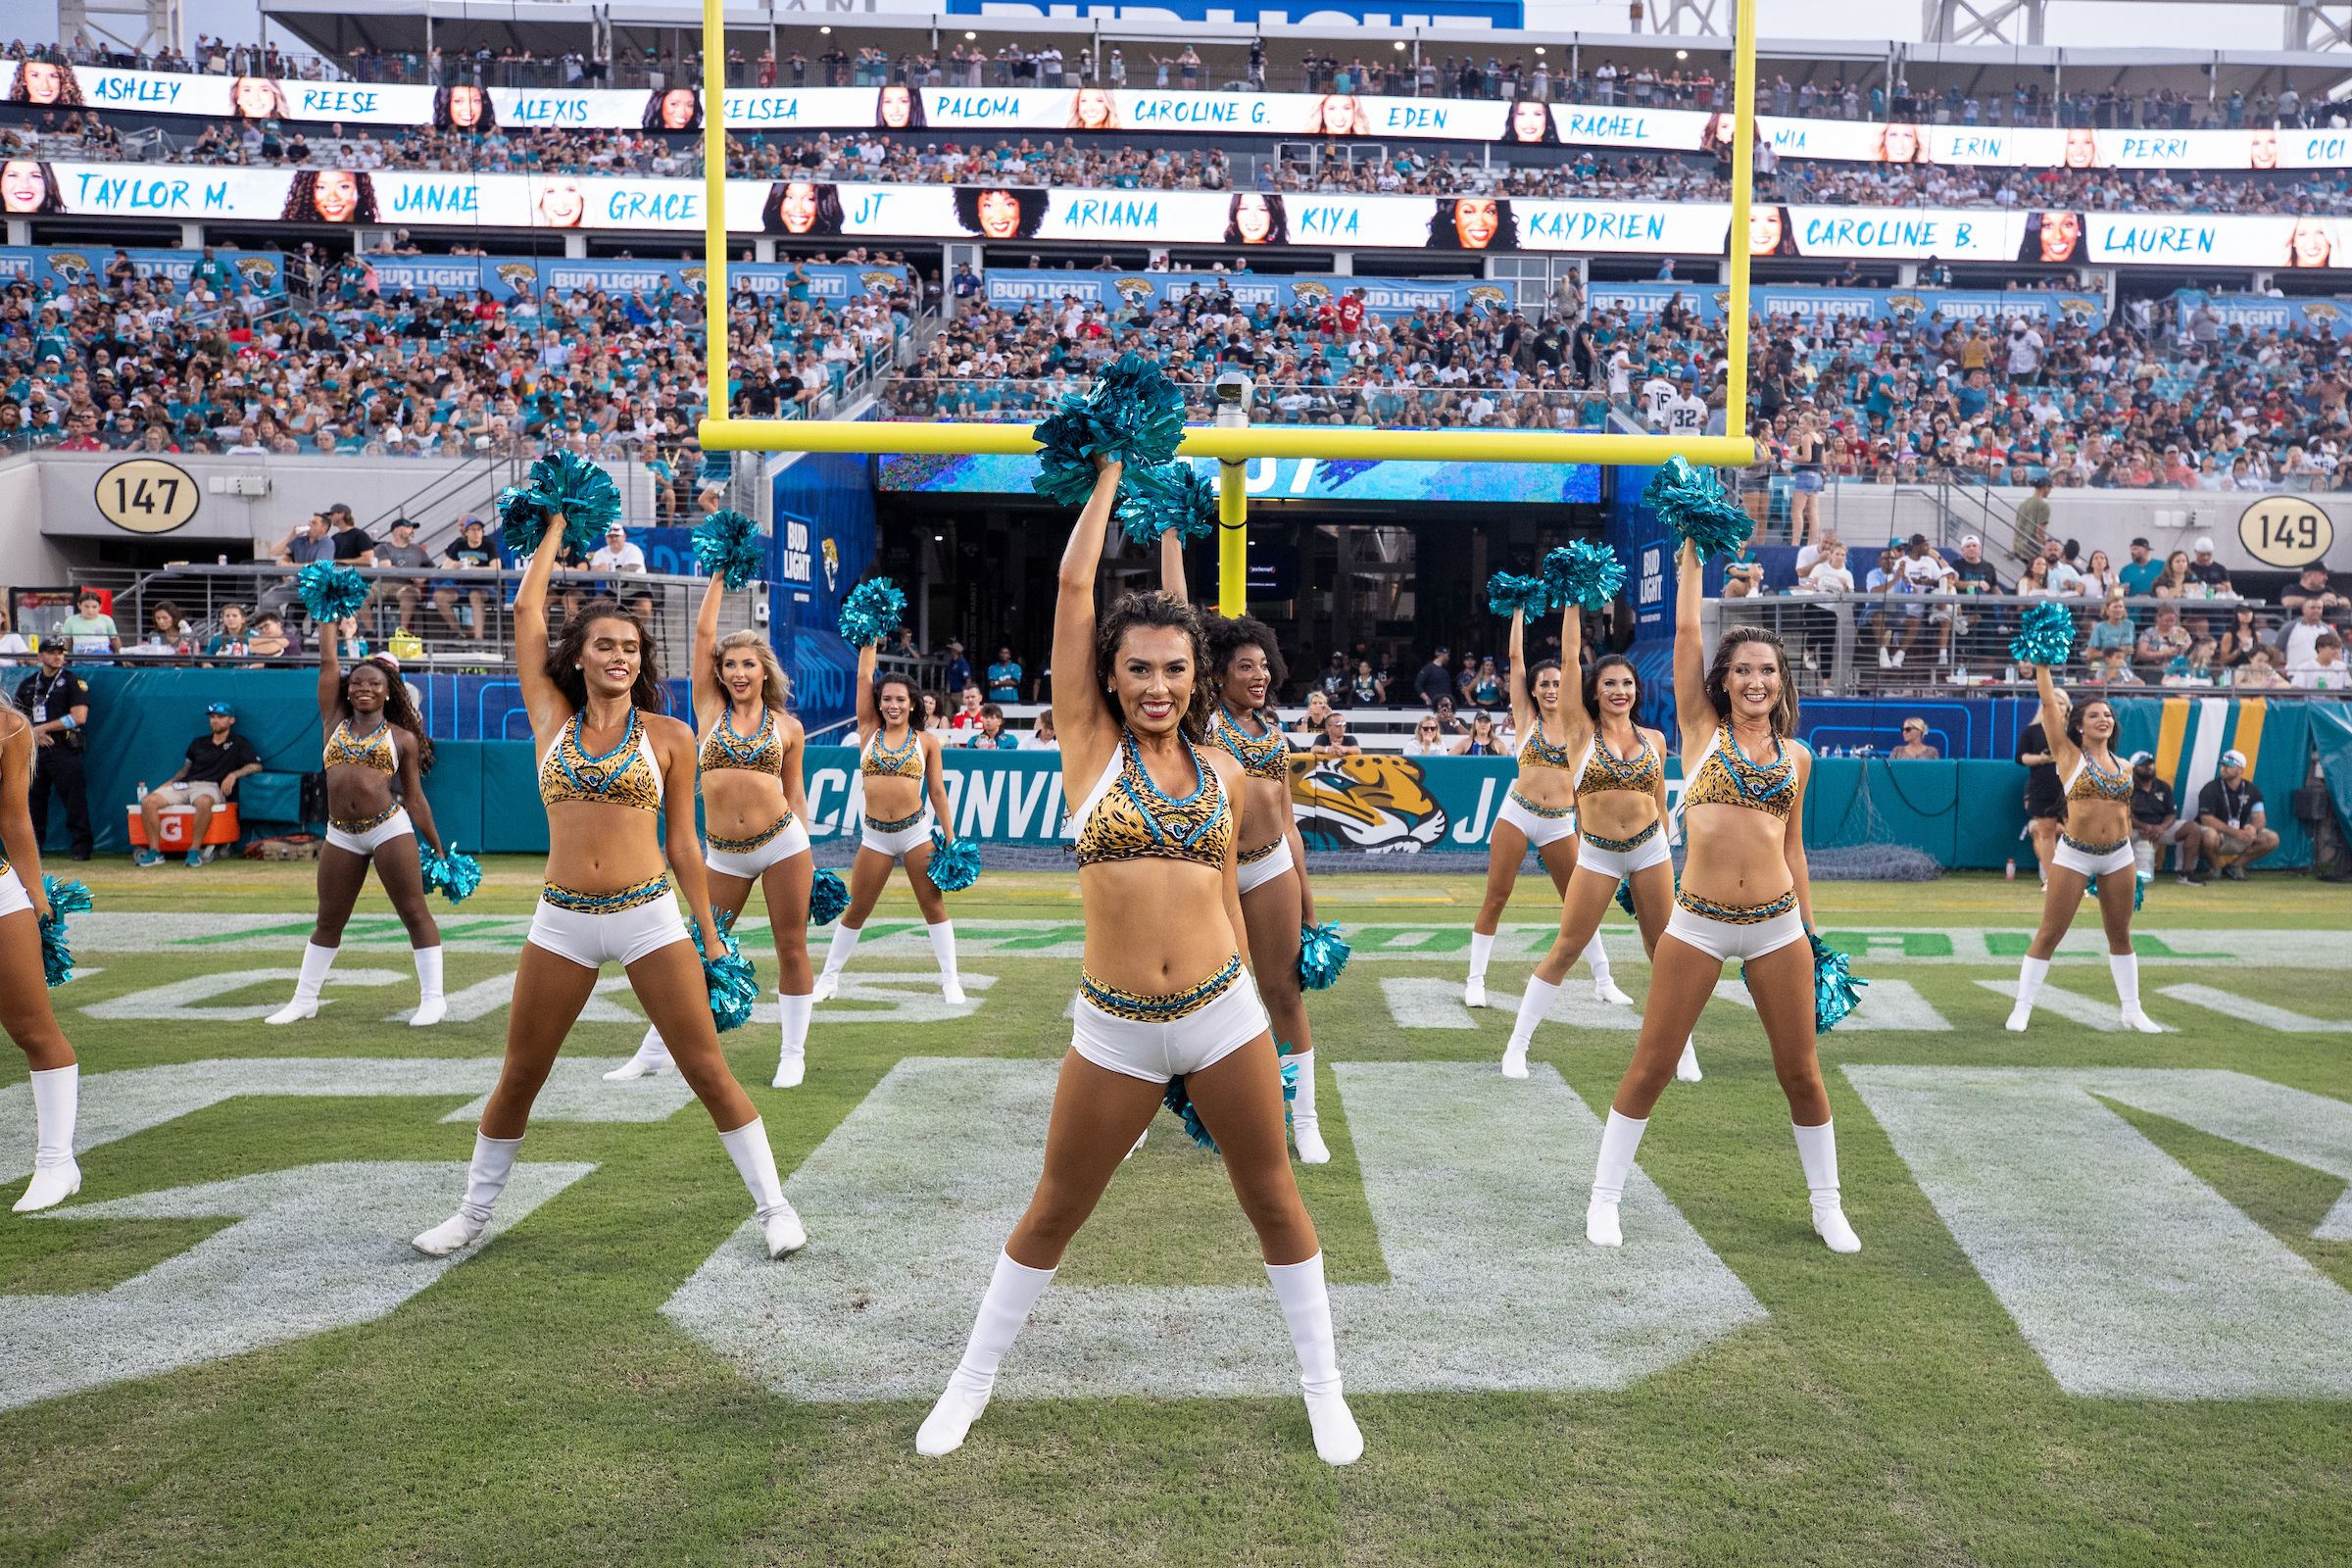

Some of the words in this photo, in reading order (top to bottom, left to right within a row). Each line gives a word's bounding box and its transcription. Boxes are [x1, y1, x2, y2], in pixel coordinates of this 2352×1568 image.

[94, 76, 181, 104] ASHLEY
[303, 90, 379, 115] REESE
[512, 99, 590, 123] ALEXIS
[936, 96, 1020, 119] PALOMA
[1134, 98, 1239, 123] CAROLINE
[1250, 102, 1271, 124] G.
[1387, 107, 1448, 129] EDEN
[1570, 114, 1649, 139] RACHEL
[1774, 129, 1806, 150] MIA
[1951, 137, 2002, 159] ERIN
[2123, 138, 2186, 159] PERRI
[2307, 139, 2346, 160] CICI
[76, 172, 191, 211] TAYLOR
[204, 180, 235, 212] M.
[393, 183, 480, 213] JANAE
[608, 190, 698, 220] GRACE
[855, 193, 894, 224] JT
[1064, 199, 1159, 228] ARIANA
[1300, 206, 1360, 236] KIYA
[1529, 212, 1666, 241] KAYDRIEN
[1806, 219, 1939, 247] CAROLINE
[1955, 222, 1979, 249] B.
[2104, 225, 2216, 254] LAUREN
[203, 263, 217, 274] 16
[416, 269, 479, 287] LIGHT
[555, 272, 599, 288] BUD
[601, 274, 662, 291] LIGHT
[993, 282, 1036, 298] BUD
[1038, 284, 1098, 301] LIGHT
[1392, 292, 1452, 309] LIGHT
[1639, 298, 1697, 315] LIGT
[1768, 299, 1811, 316] BUD
[1812, 301, 1871, 318] LIGHT
[1940, 303, 1984, 320] BUD
[1985, 305, 2042, 321] LIGHT
[1674, 409, 1696, 428] 32
[116, 477, 179, 515] 147
[787, 520, 808, 554] BUD
[2259, 514, 2319, 550] 149
[784, 549, 811, 583] LIGHT
[1642, 548, 1661, 577] BUD
[1639, 573, 1663, 606] LIGHT
[160, 816, 183, 842] G
